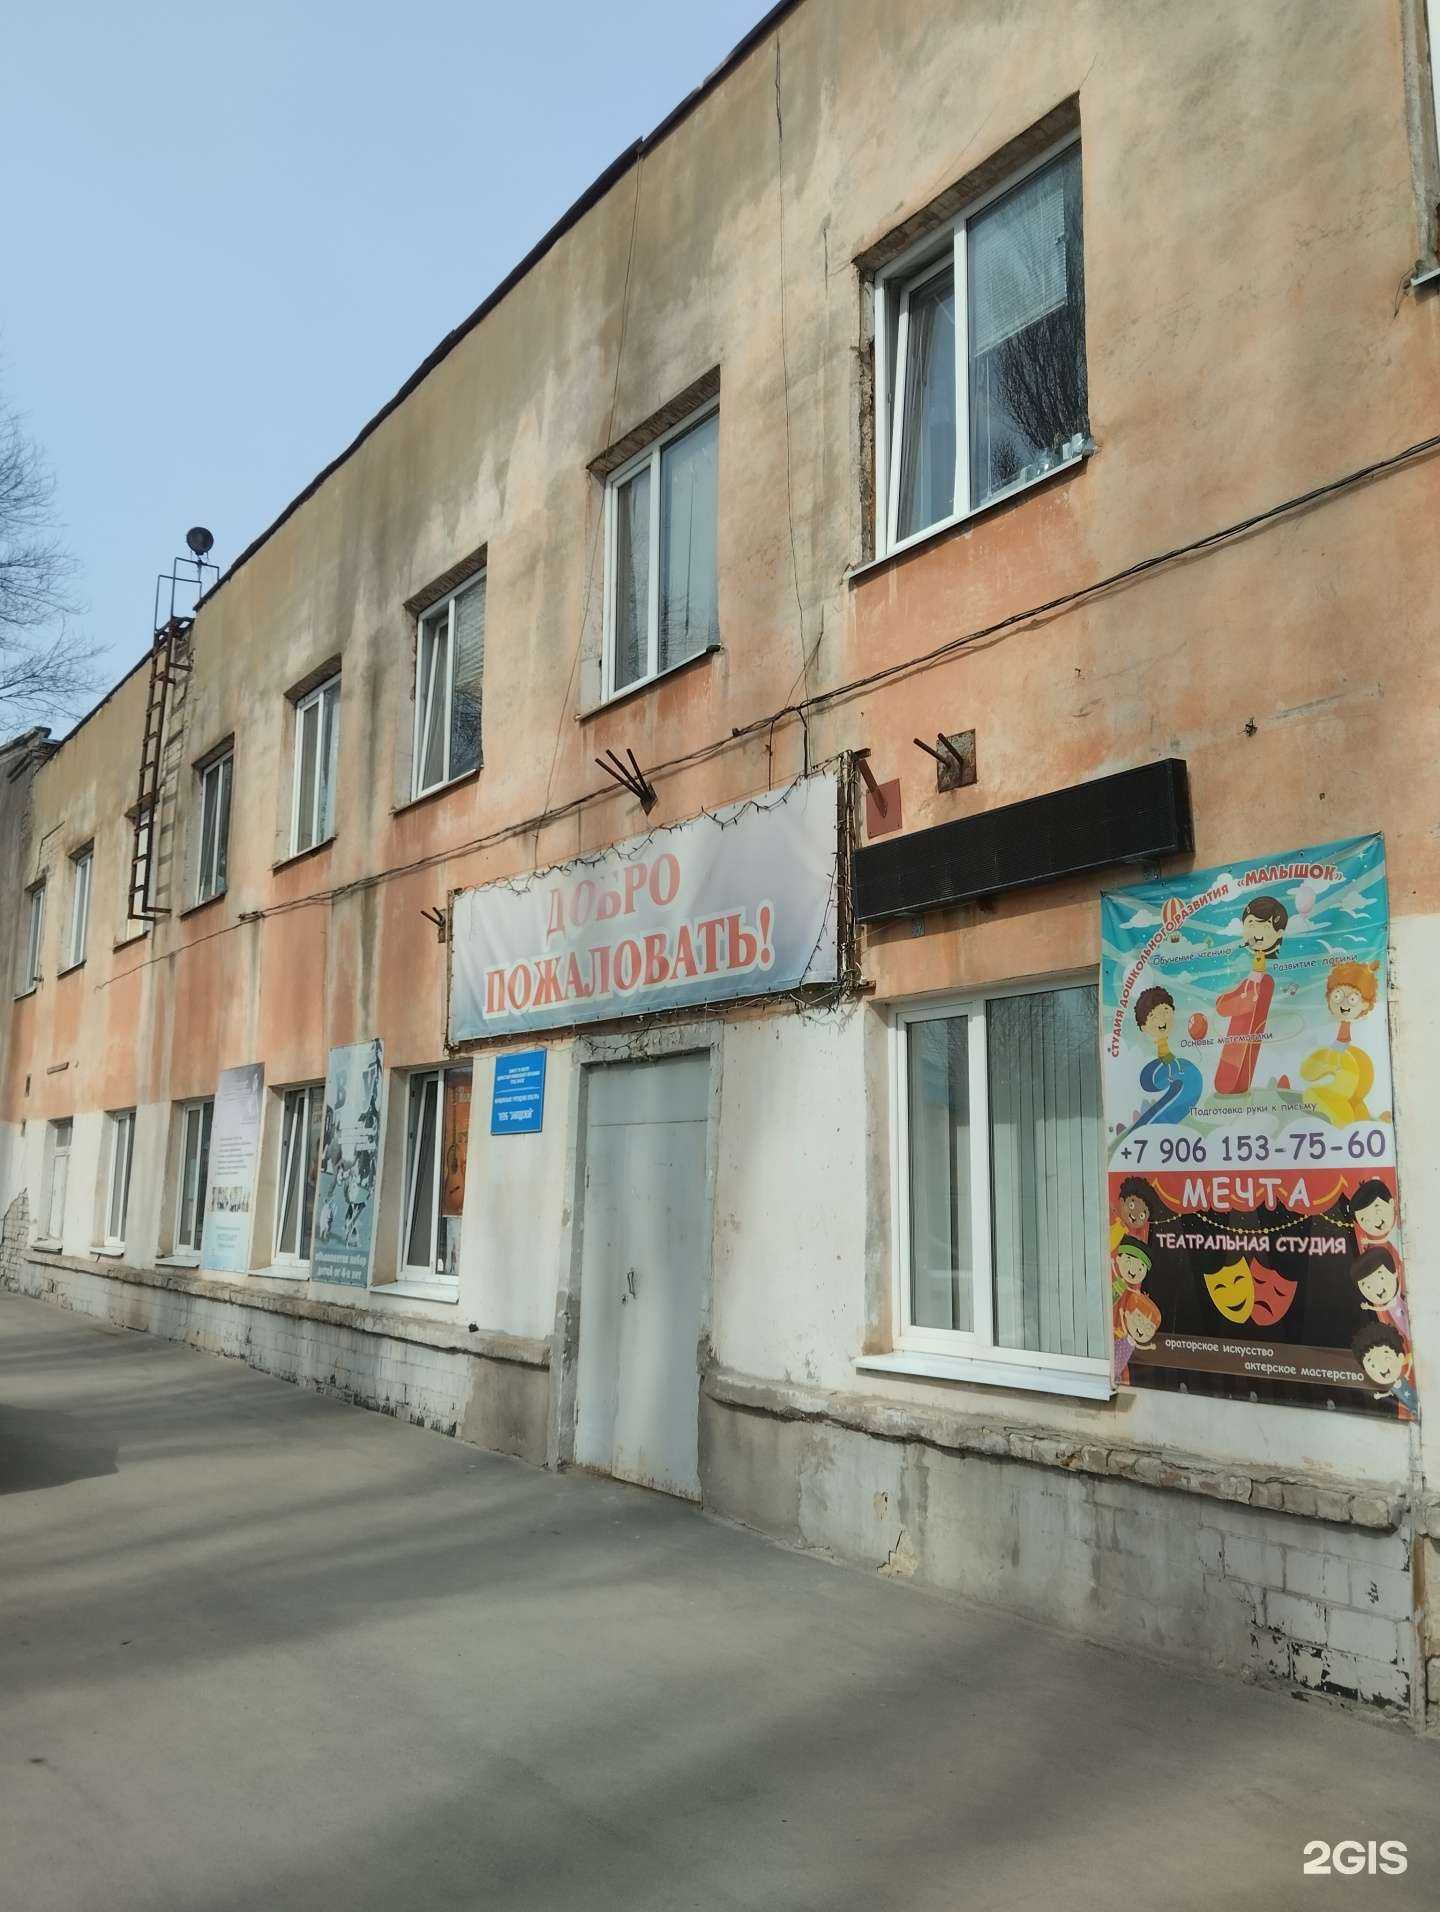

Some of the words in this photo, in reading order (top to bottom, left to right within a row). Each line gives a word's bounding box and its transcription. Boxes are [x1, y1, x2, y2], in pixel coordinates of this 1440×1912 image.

[485, 906, 772, 1014] ПОЖАЛОВАТЬ!
[1111, 1010, 1124, 1057] СТУДИЯ
[1120, 921, 1175, 1009] ДОШКОЛЬНОГО
[1174, 884, 1229, 926] РАЗВИТИЯ
[1190, 1107, 1243, 1116] Подготовка
[1246, 1105, 1268, 1115] руки
[1281, 1103, 1317, 1113] письму
[1121, 1139, 1148, 1164] +7
[1160, 1137, 1207, 1163] 906
[1222, 1129, 1386, 1161] 153-75-60
[1182, 1176, 1311, 1209] МЕЧТА
[1156, 1233, 1270, 1252] ТЕАТРАЛЬНАЯ
[1275, 1236, 1347, 1256] СТУДИЯ
[1165, 1338, 1219, 1353] ораторское
[1222, 1342, 1275, 1357] искусство
[1244, 1361, 1297, 1376] актерское
[1300, 1366, 1365, 1382] мастерство
